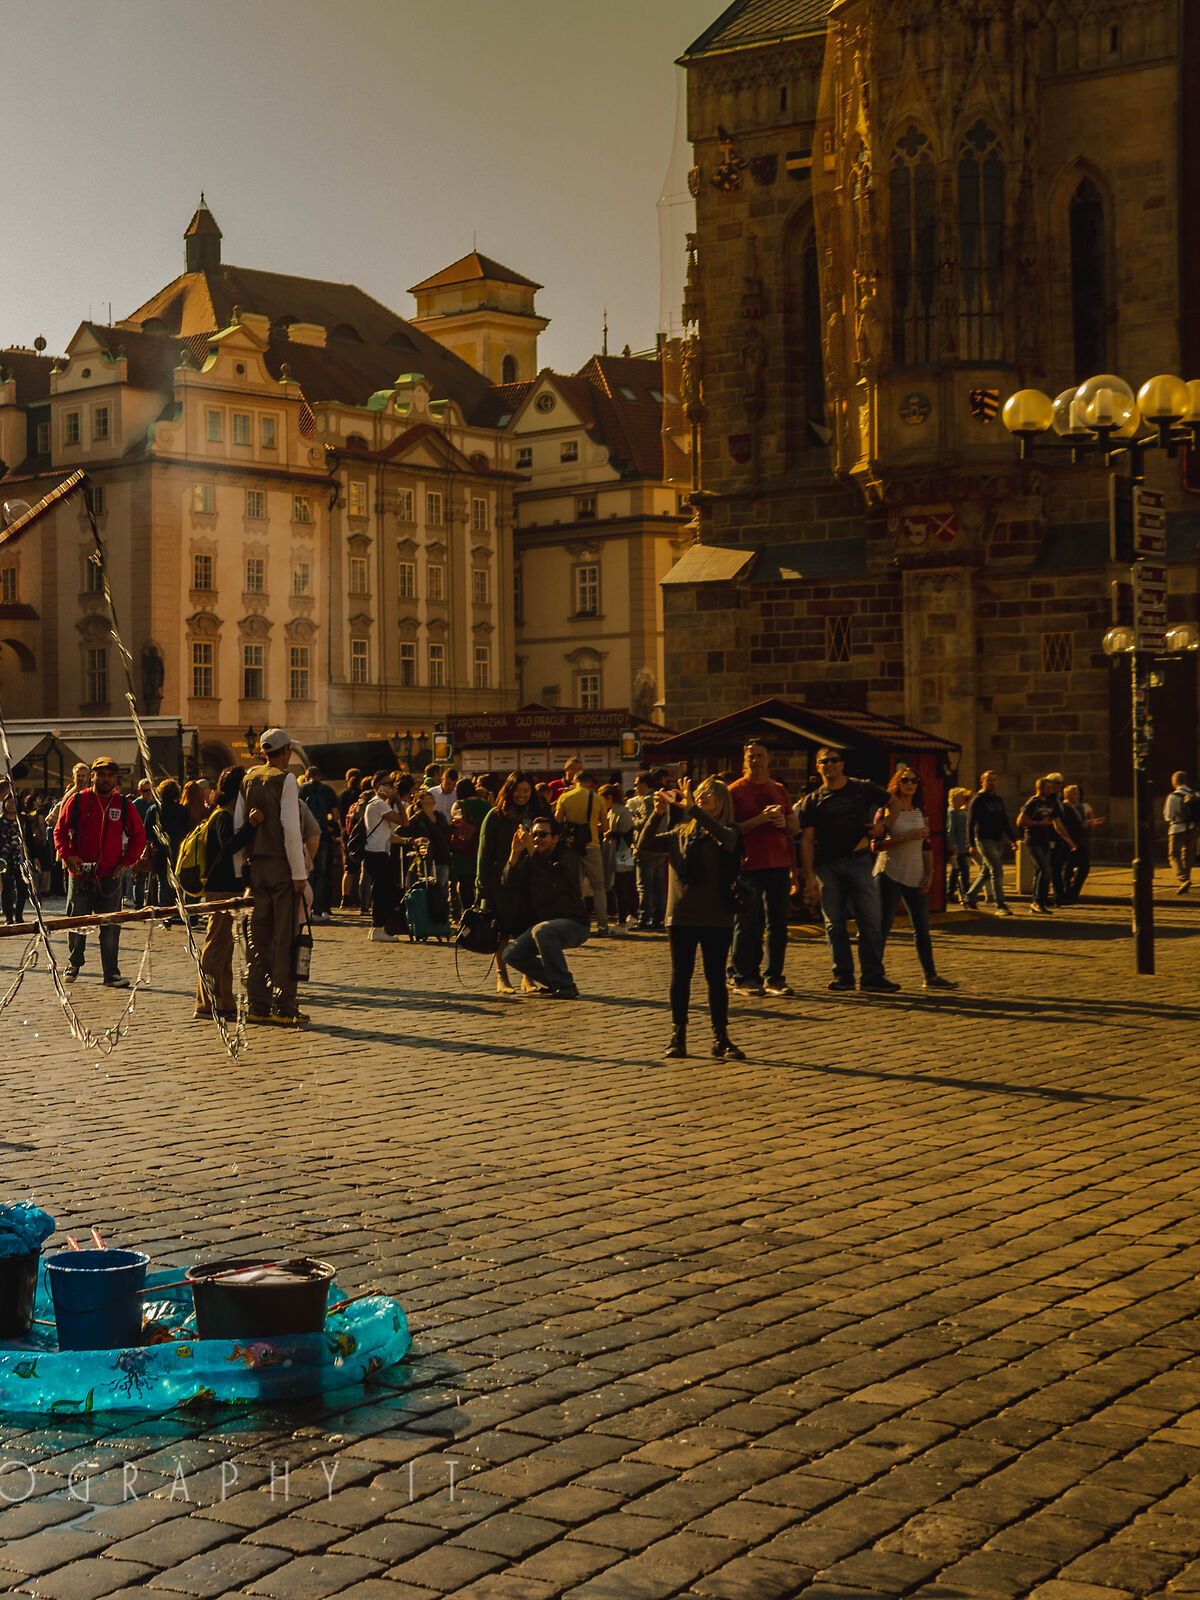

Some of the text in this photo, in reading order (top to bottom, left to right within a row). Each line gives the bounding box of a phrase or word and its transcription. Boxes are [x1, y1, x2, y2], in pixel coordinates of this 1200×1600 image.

[515, 714, 567, 727] OLD PRAGUE
[573, 713, 625, 725] PROSCIUTTO
[531, 728, 551, 739] HAM
